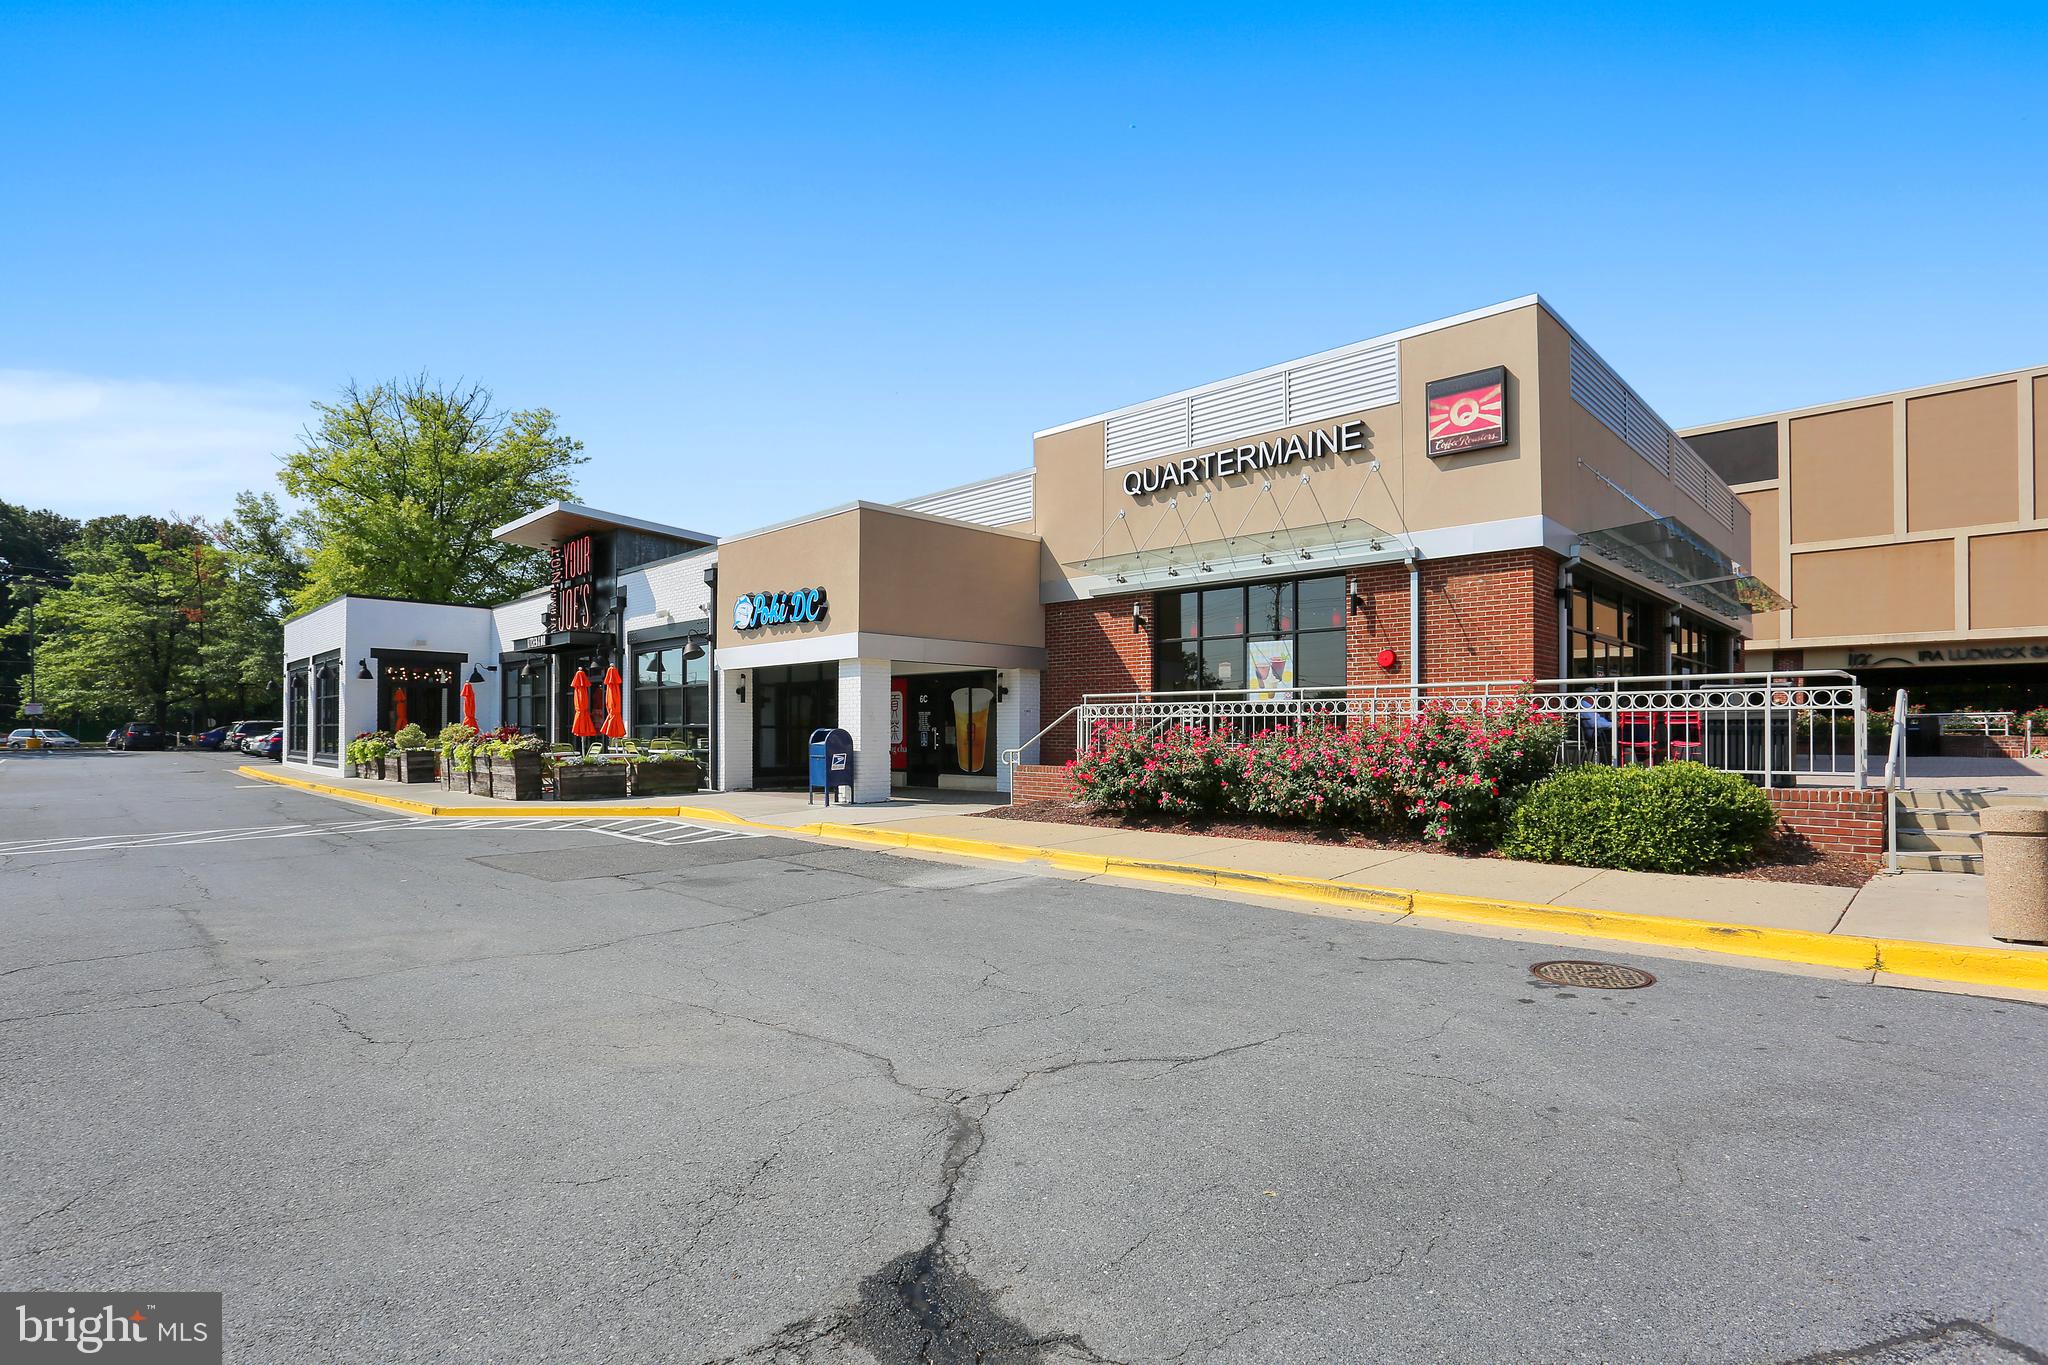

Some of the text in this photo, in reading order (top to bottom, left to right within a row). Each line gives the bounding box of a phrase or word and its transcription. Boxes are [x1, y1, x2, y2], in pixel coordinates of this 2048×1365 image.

[1123, 420, 1363, 496] QUARTERMAINE
[551, 547, 561, 584] NOT
[563, 536, 591, 579] YOUR
[558, 583, 590, 631] JOE'S
[750, 589, 821, 627] Poki DC
[1918, 650, 1944, 663] IRA
